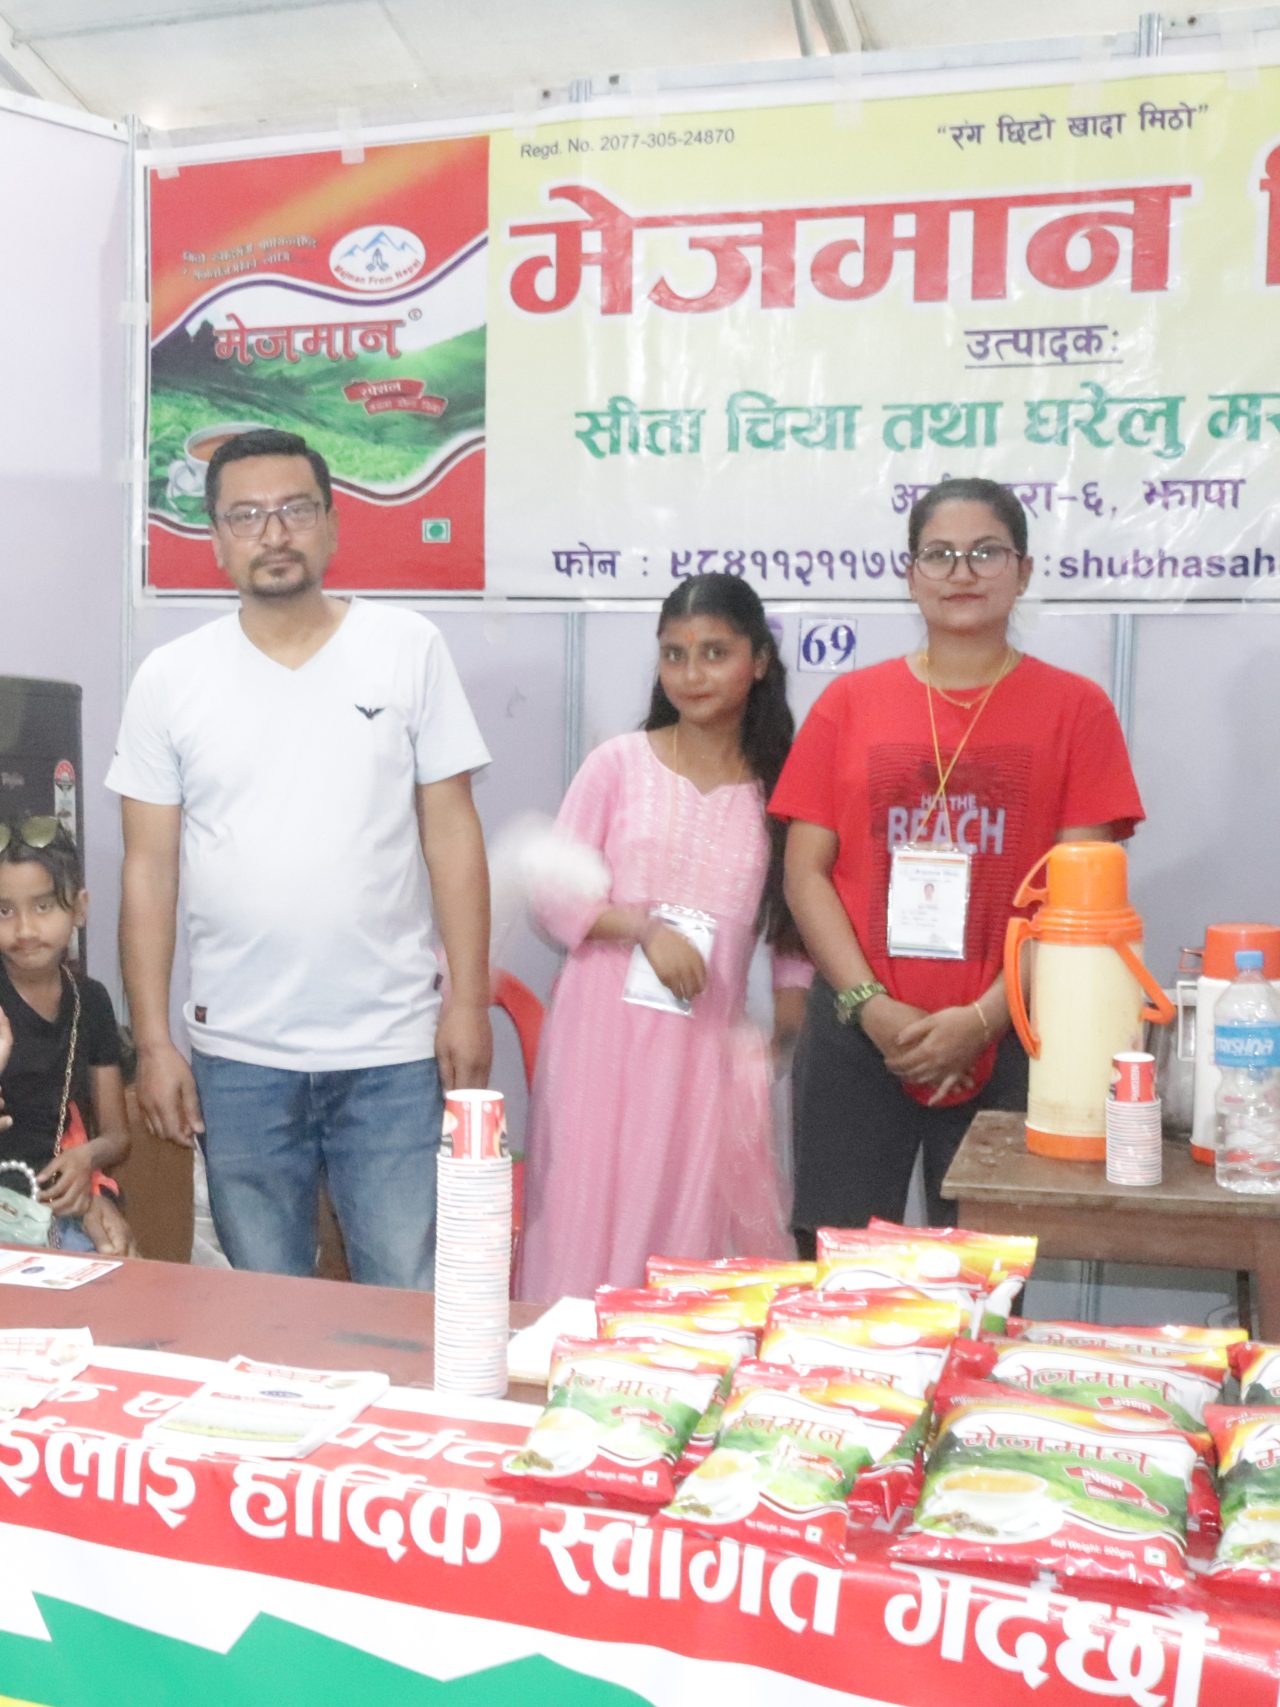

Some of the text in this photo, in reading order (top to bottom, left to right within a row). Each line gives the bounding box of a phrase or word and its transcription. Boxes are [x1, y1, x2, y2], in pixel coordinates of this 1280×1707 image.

[520, 128, 735, 159] Regd. No. 2077-305-24870
[997, 114, 1056, 144] छिटो
[1068, 113, 1127, 138] खादा
[509, 184, 1192, 316] मेजमान
[369, 275, 393, 285] From
[213, 313, 406, 365] मेजमान
[575, 396, 706, 458] सीता
[726, 390, 863, 452] चिया
[881, 401, 1003, 453] तथा
[1024, 381, 1186, 459] घरेलु
[552, 542, 621, 579] फोन
[802, 624, 856, 665] 69
[949, 794, 976, 811] THE
[888, 806, 1006, 855] BEACH
[963, 1425, 1154, 1477] मेजमान
[229, 1461, 514, 1567] हार्दिक
[540, 1501, 842, 1636] स्वागत
